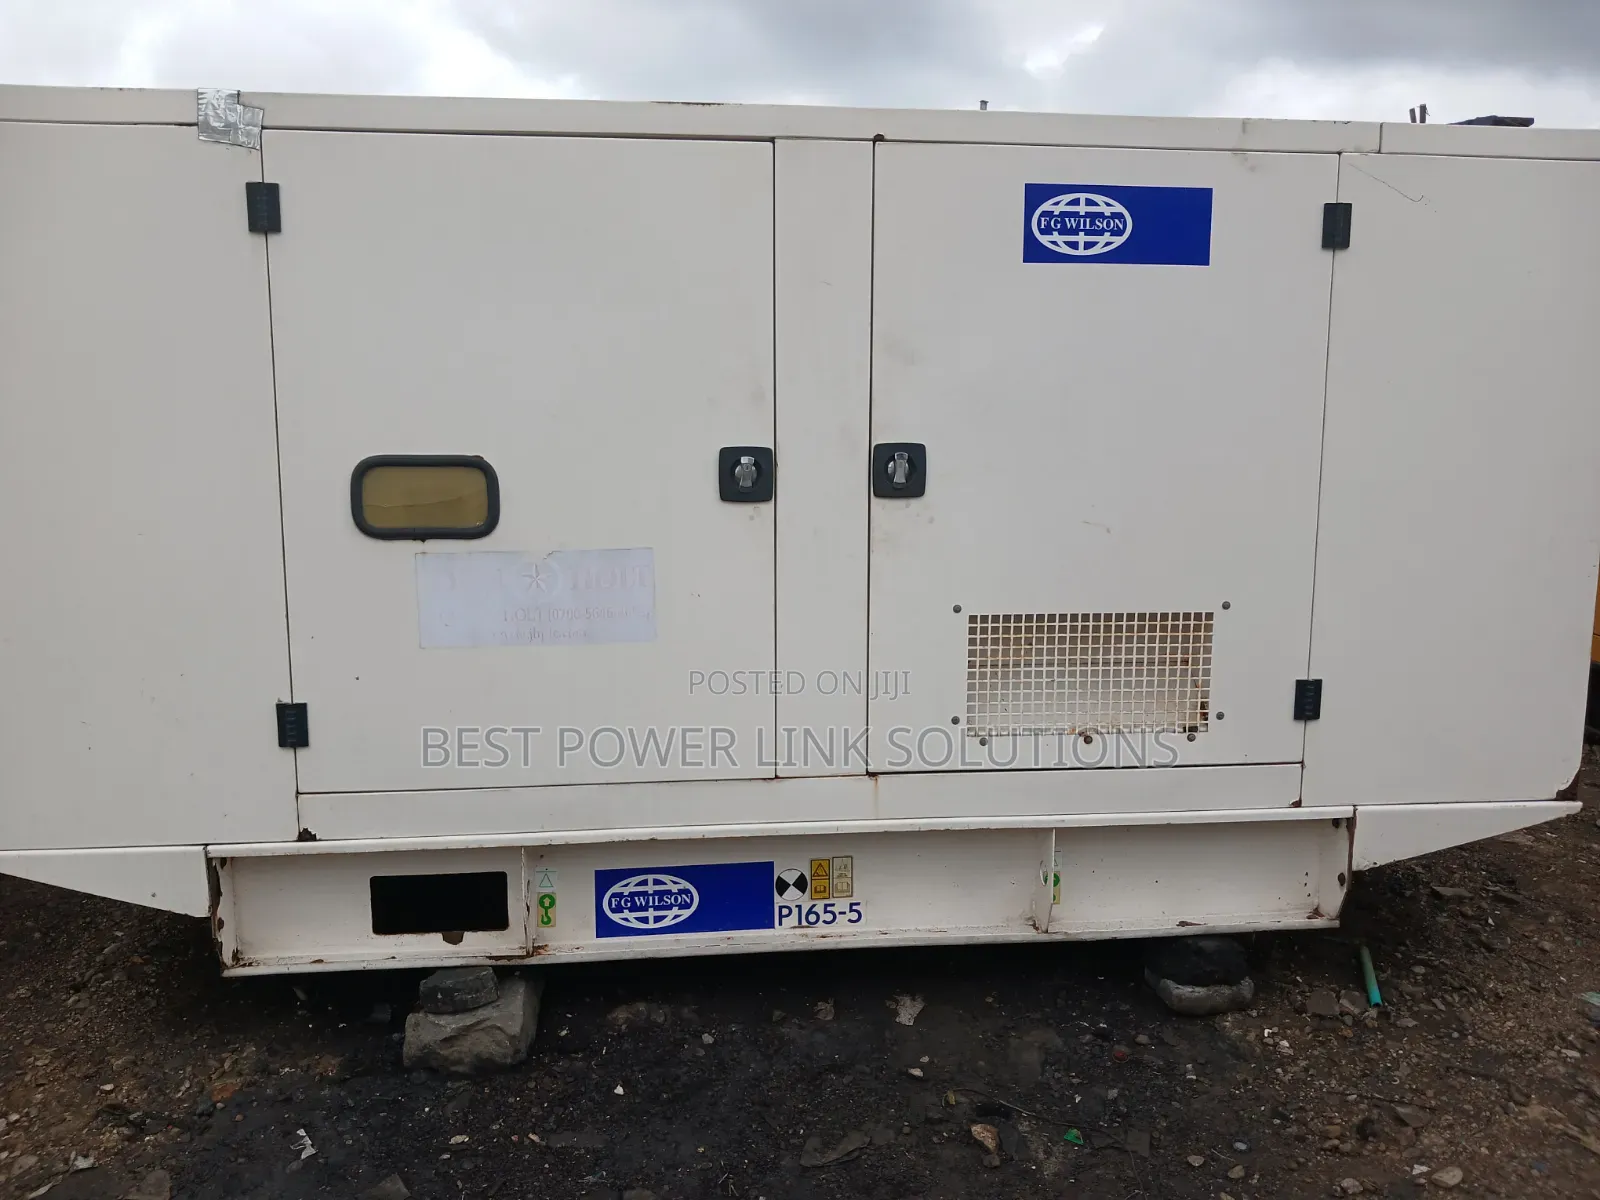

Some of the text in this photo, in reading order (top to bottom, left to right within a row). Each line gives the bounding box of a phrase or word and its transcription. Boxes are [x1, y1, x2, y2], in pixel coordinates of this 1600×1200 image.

[1040, 217, 1125, 231] FG WILSON
[611, 893, 691, 908] FG WILSON
[778, 901, 862, 926] P165-5
